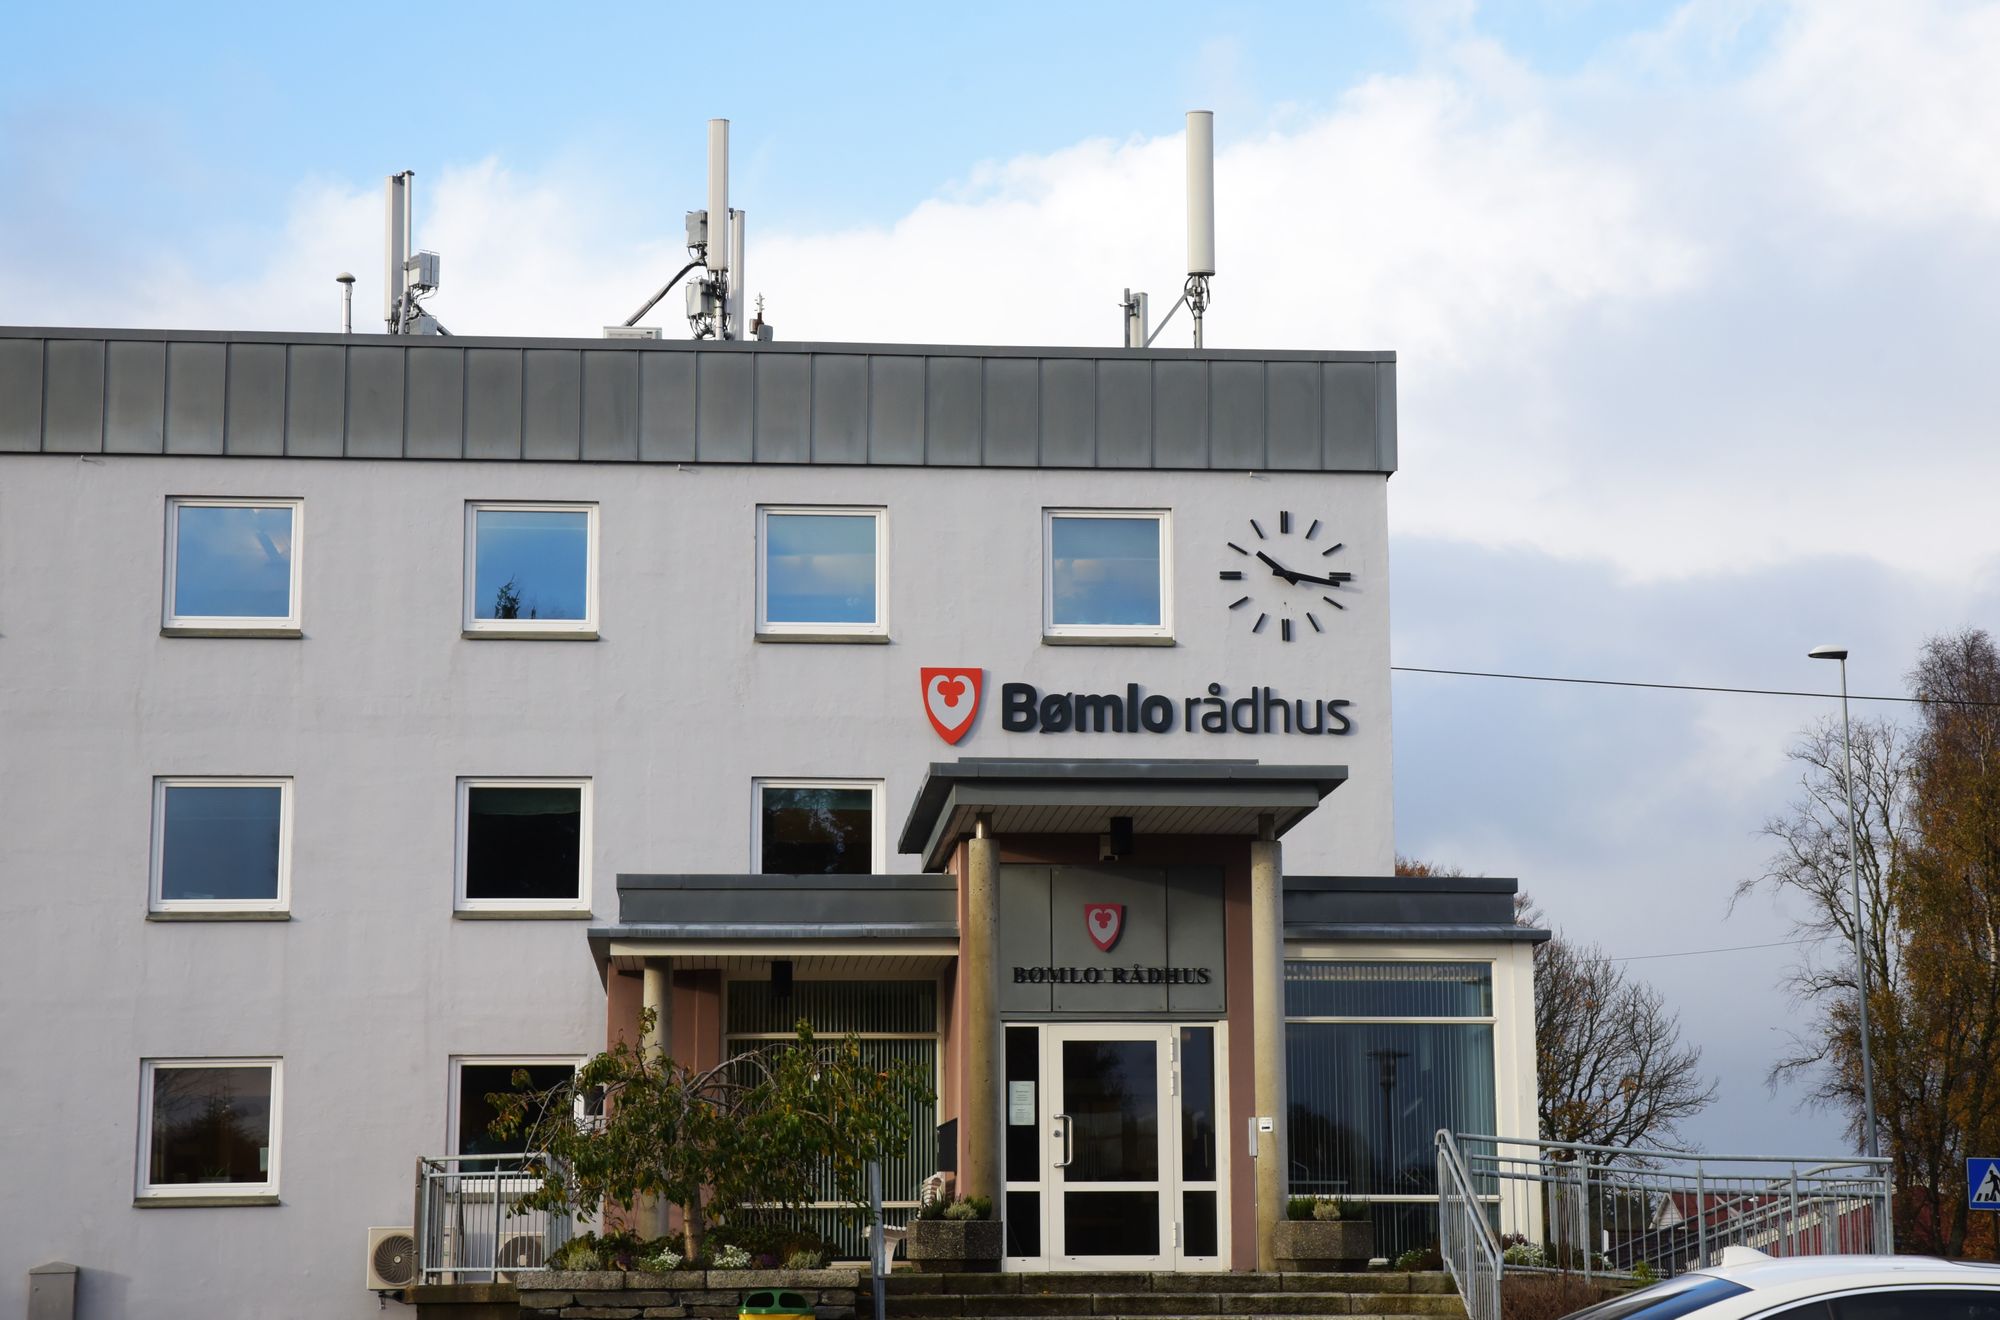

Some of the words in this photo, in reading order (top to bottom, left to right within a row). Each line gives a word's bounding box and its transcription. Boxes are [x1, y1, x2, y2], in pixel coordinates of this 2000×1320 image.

[1001, 682, 1173, 734] Bømlo
[1185, 682, 1351, 735] rådhus
[1013, 966, 1100, 984] BØMLO
[1112, 963, 1209, 984] RÅDHUS
